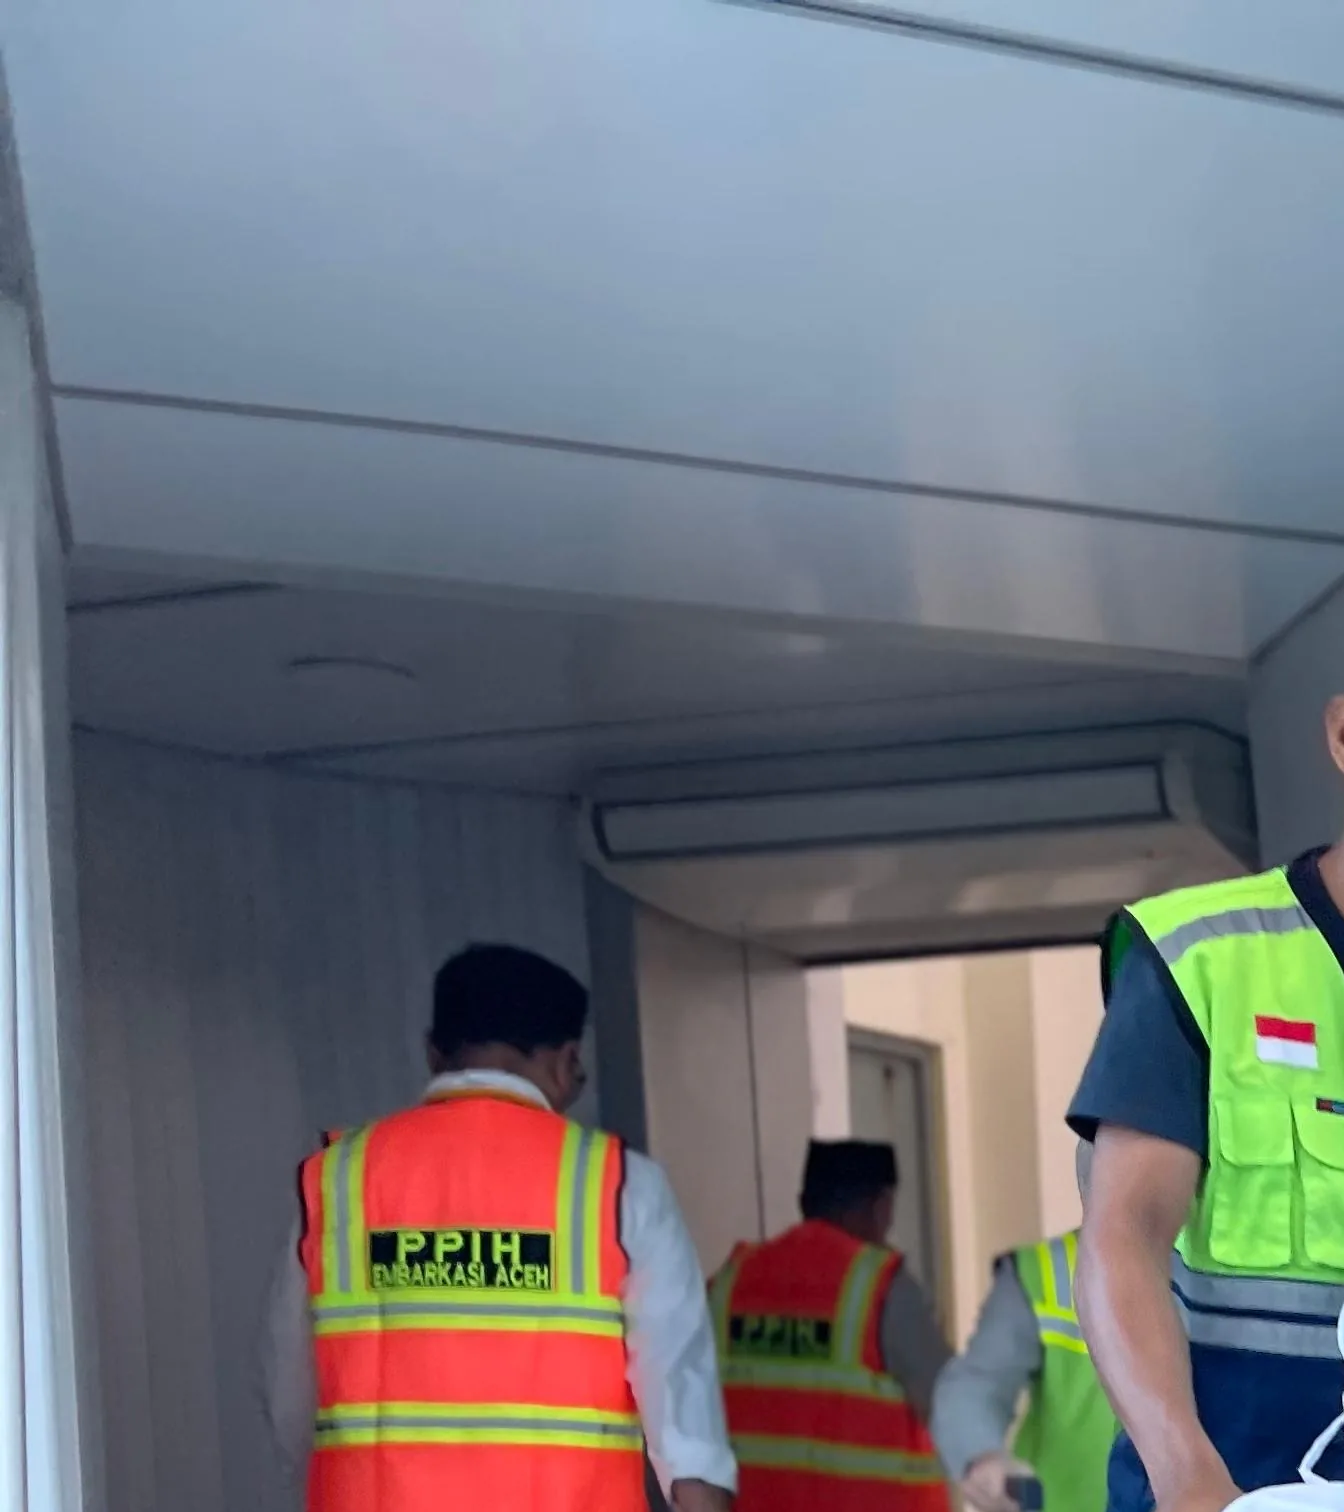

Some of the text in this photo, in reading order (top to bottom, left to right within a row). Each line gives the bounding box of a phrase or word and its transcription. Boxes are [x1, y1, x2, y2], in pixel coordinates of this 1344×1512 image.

[397, 1231, 521, 1264] PPIH
[372, 1262, 549, 1289] EMBARKASI ACEH
